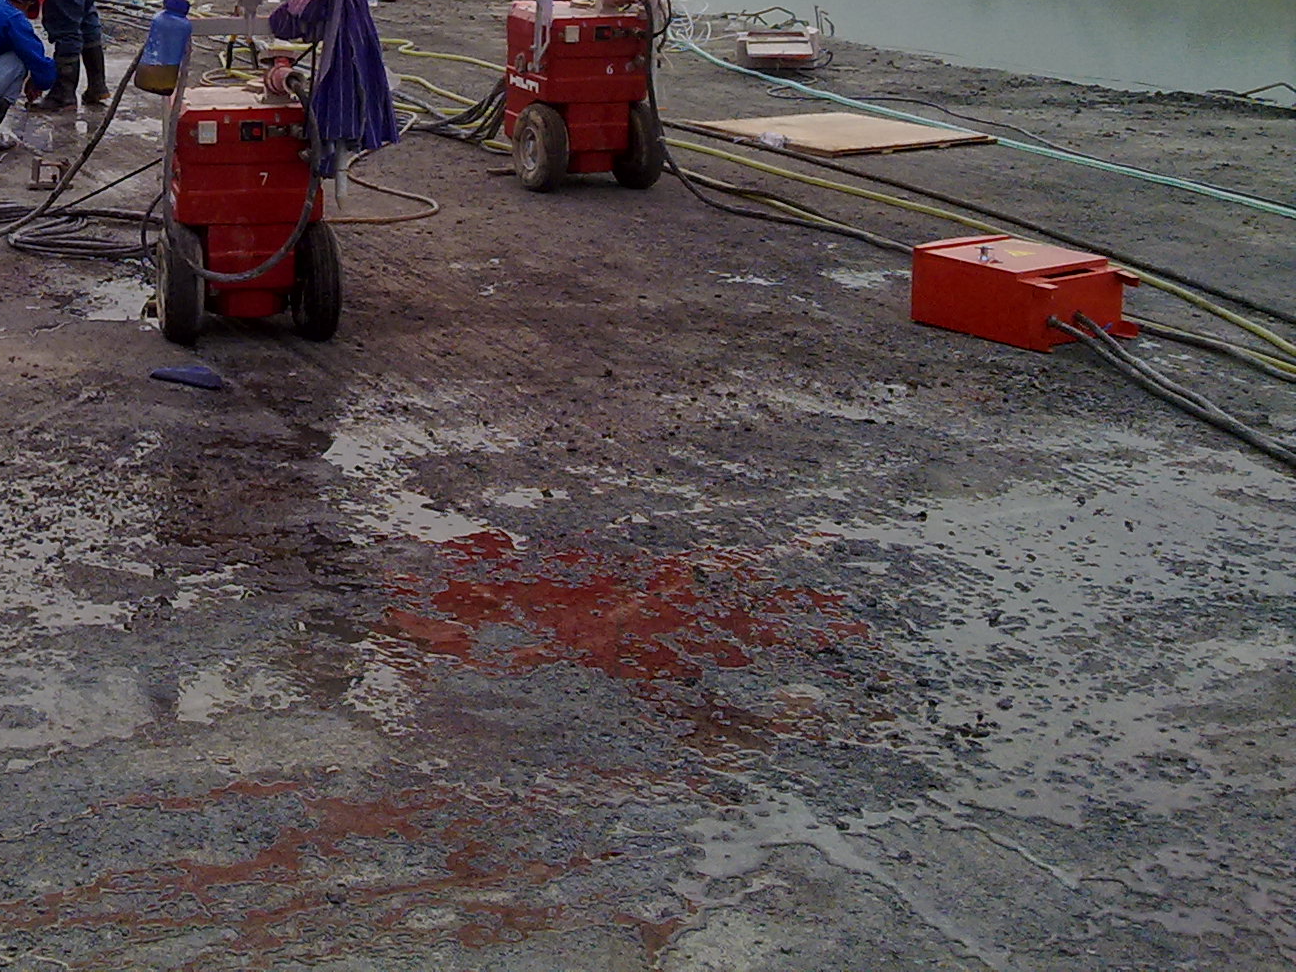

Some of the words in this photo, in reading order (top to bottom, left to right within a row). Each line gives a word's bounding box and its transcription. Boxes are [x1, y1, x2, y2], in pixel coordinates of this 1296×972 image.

[606, 63, 614, 75] 6
[509, 73, 539, 94] HILTI
[259, 172, 269, 186] 7
